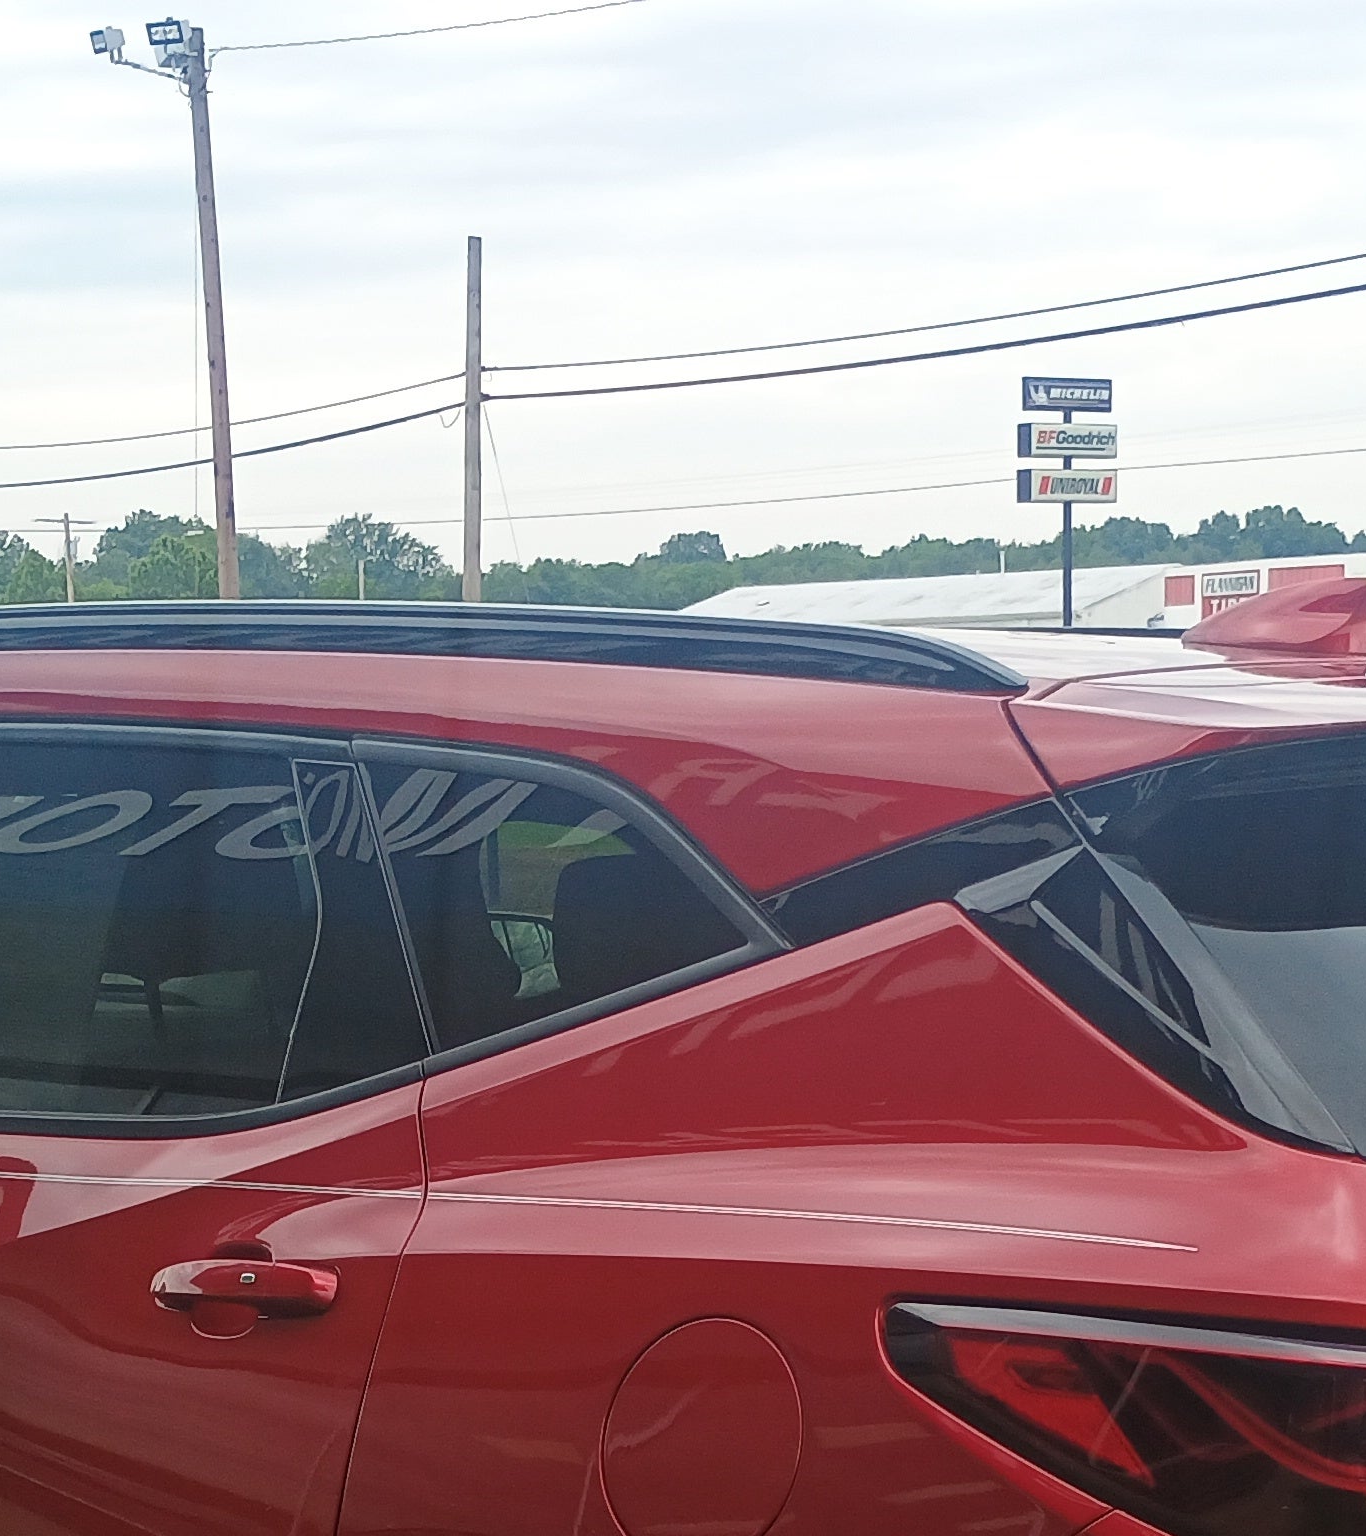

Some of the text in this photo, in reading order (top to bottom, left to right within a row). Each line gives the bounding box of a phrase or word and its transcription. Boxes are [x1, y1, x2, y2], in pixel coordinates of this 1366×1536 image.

[1049, 387, 1110, 400] MICHELIN
[1036, 430, 1115, 446] BFGoodrich
[1049, 477, 1100, 495] UNIROYAL
